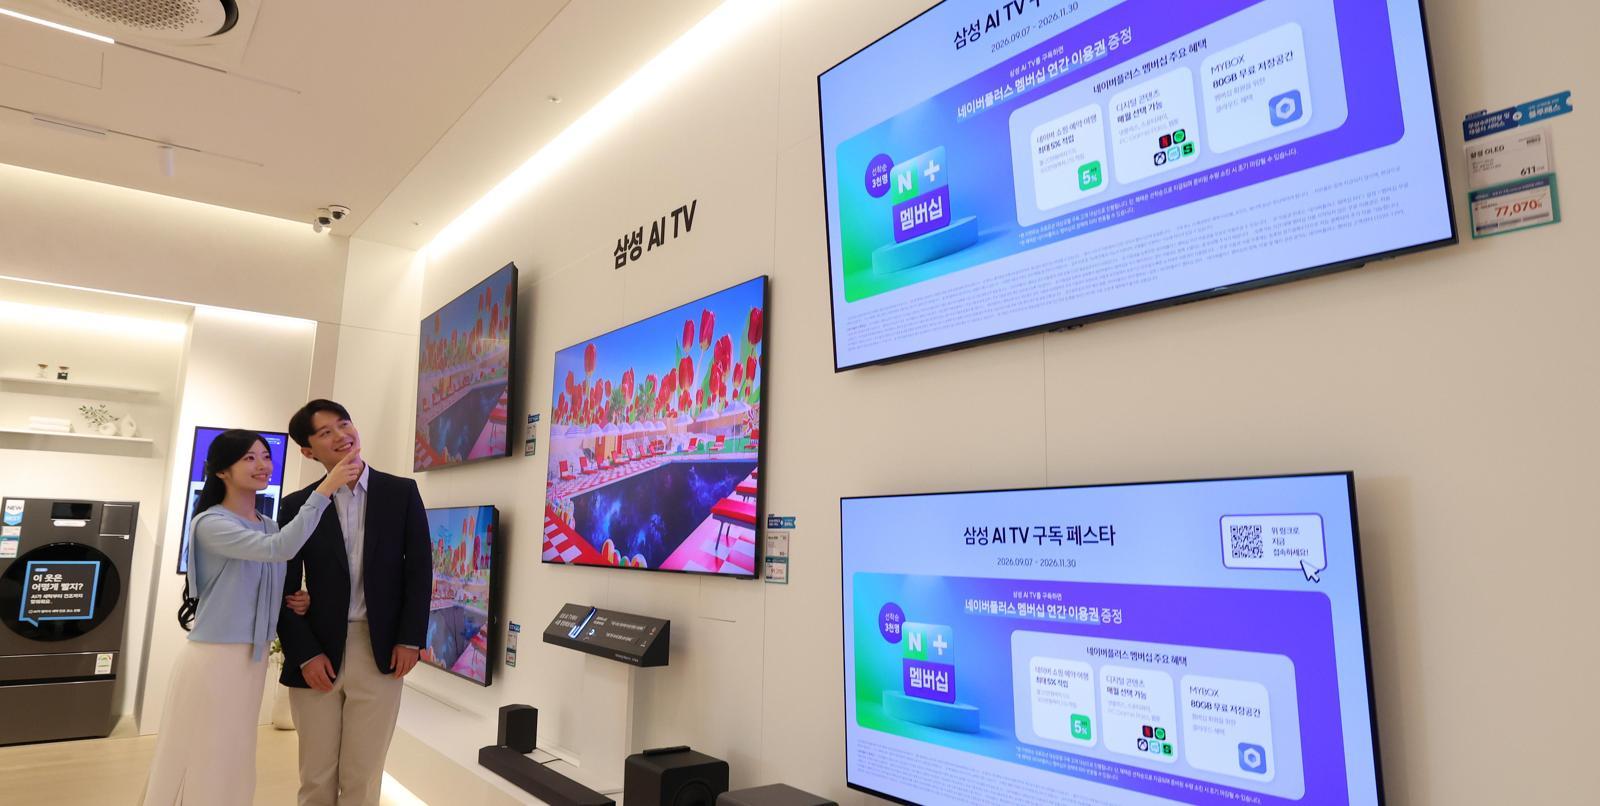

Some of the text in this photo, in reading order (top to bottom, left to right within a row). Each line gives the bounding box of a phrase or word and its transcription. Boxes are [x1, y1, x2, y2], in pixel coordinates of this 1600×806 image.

[954, 0, 1026, 50] 삼성 AI TV
[991, 27, 1031, 53] 2026.09.07
[1038, 1, 1079, 29] 2026.11.30
[957, 26, 1133, 119] 네이버플러스 멤버십 연간 이용권 증정
[1093, 37, 1208, 93] 네이버플러스 멤버십 주요 혜택
[1211, 54, 1246, 75] MYBOX
[1213, 50, 1294, 89] 80GB 무료 저장공간
[1484, 144, 1505, 156] OLED
[872, 162, 888, 177] 선착순
[872, 173, 889, 189] 3천명
[897, 170, 913, 194] N
[900, 195, 944, 232] 멤버십
[614, 199, 697, 270] 삼성 AI TV
[963, 524, 1116, 546] 삼성 AI TV 구독 페스타
[997, 557, 1033, 568] 2026.09.07
[1040, 558, 1077, 569] 2026.11.30
[31, 582, 84, 592] 어떻게 빨지?
[33, 574, 43, 582] 이
[44, 573, 63, 583] 옷은
[884, 612, 900, 622] 선착순
[965, 598, 1123, 624] 네이버플러스 멤버십 연간 이용권 증정
[884, 622, 901, 635] 3천명
[908, 631, 923, 652] N
[1086, 646, 1188, 667] 네이버플러스 멤버십 주요 혜택
[909, 666, 950, 694] 멤버십
[1189, 685, 1220, 699] MYBOX
[1190, 698, 1262, 719] 80GB 무료 저장공간
